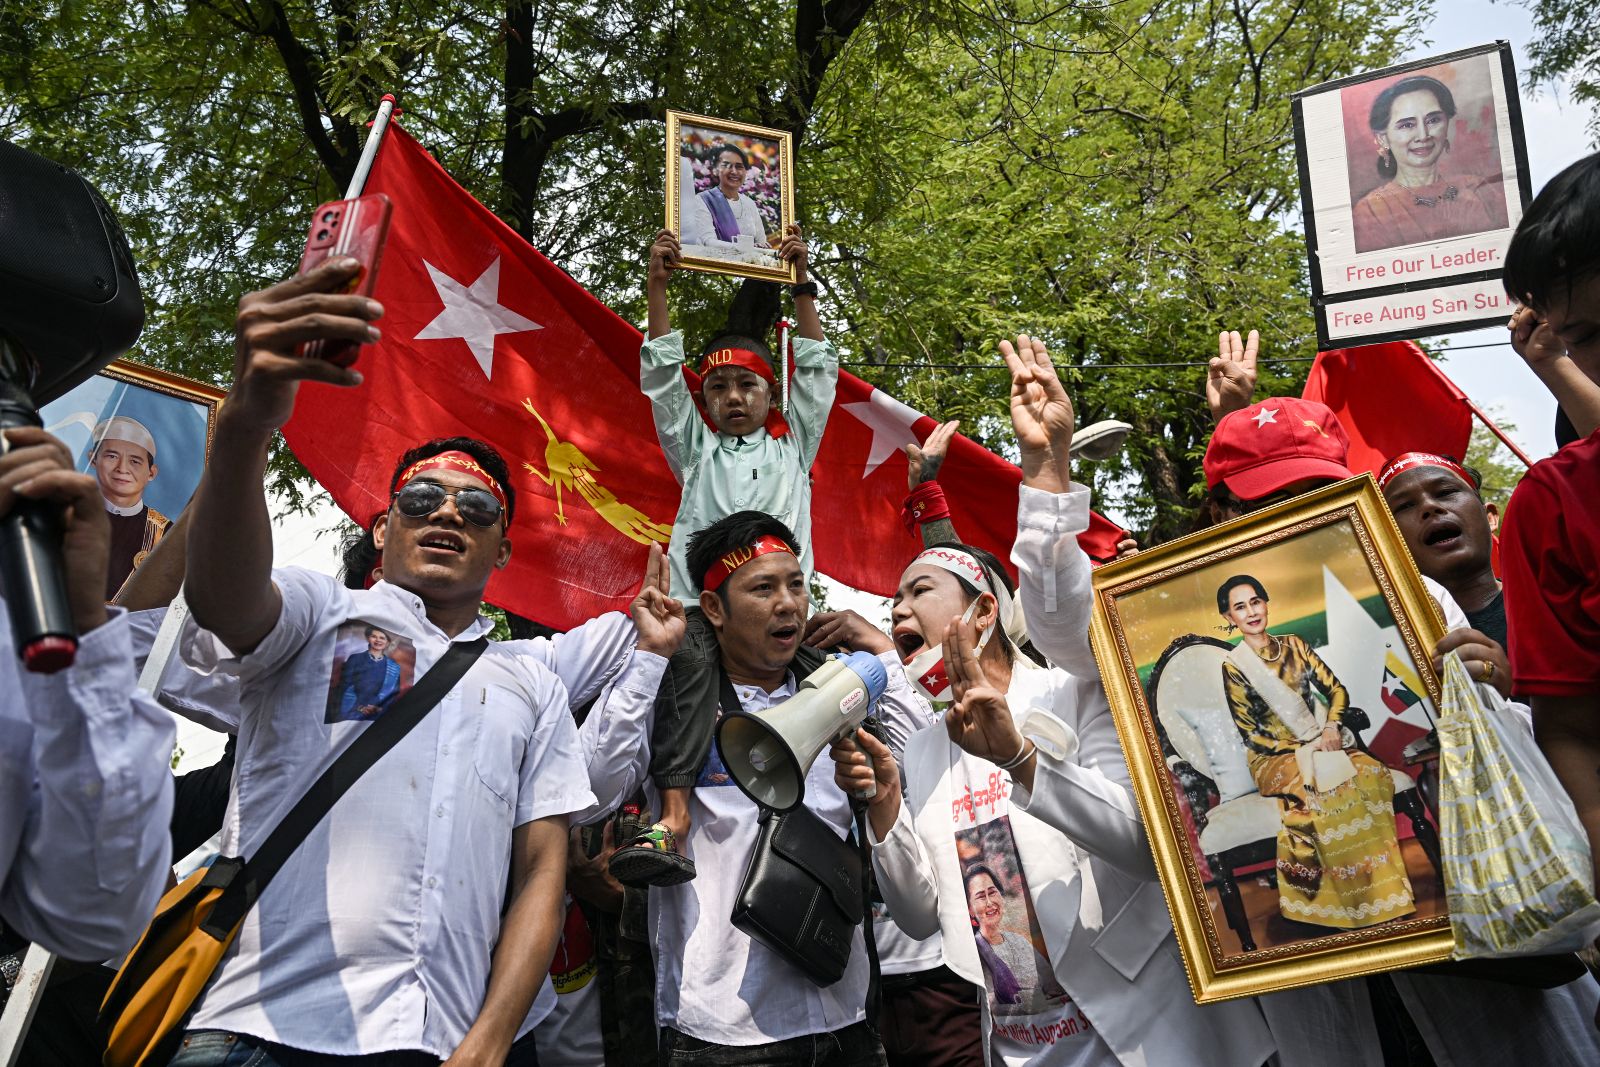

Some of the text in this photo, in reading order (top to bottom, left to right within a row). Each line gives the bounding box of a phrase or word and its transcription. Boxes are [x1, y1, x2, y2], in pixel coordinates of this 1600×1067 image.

[1346, 248, 1500, 281] Free Our Leader.
[1334, 311, 1373, 327] Free
[1379, 305, 1426, 322] Aung
[1432, 298, 1468, 314] San
[1474, 293, 1499, 309] Su
[708, 349, 732, 369] NLD
[721, 545, 752, 574] NLD
